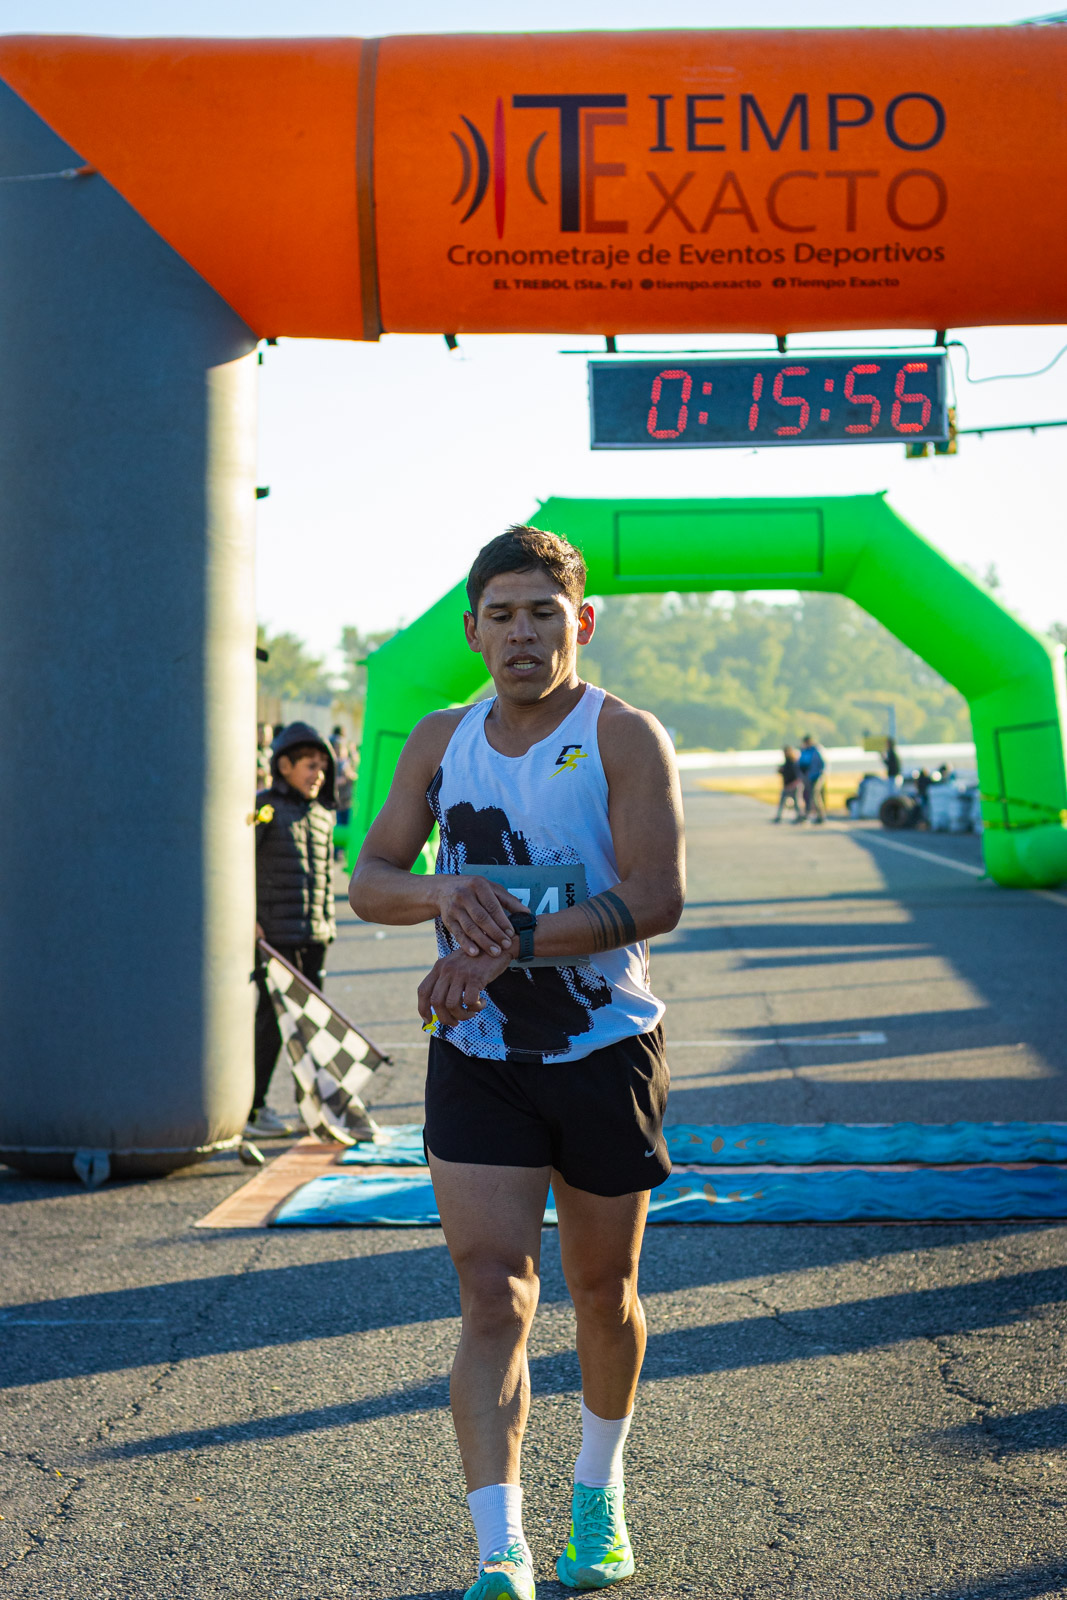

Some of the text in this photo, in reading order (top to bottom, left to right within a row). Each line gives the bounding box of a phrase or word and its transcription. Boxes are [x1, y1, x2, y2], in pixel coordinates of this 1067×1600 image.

[447, 242, 945, 269] Cronometraje de Eventos Deportivos
[789, 277, 846, 290] Tiempo
[849, 276, 900, 288] Exacto
